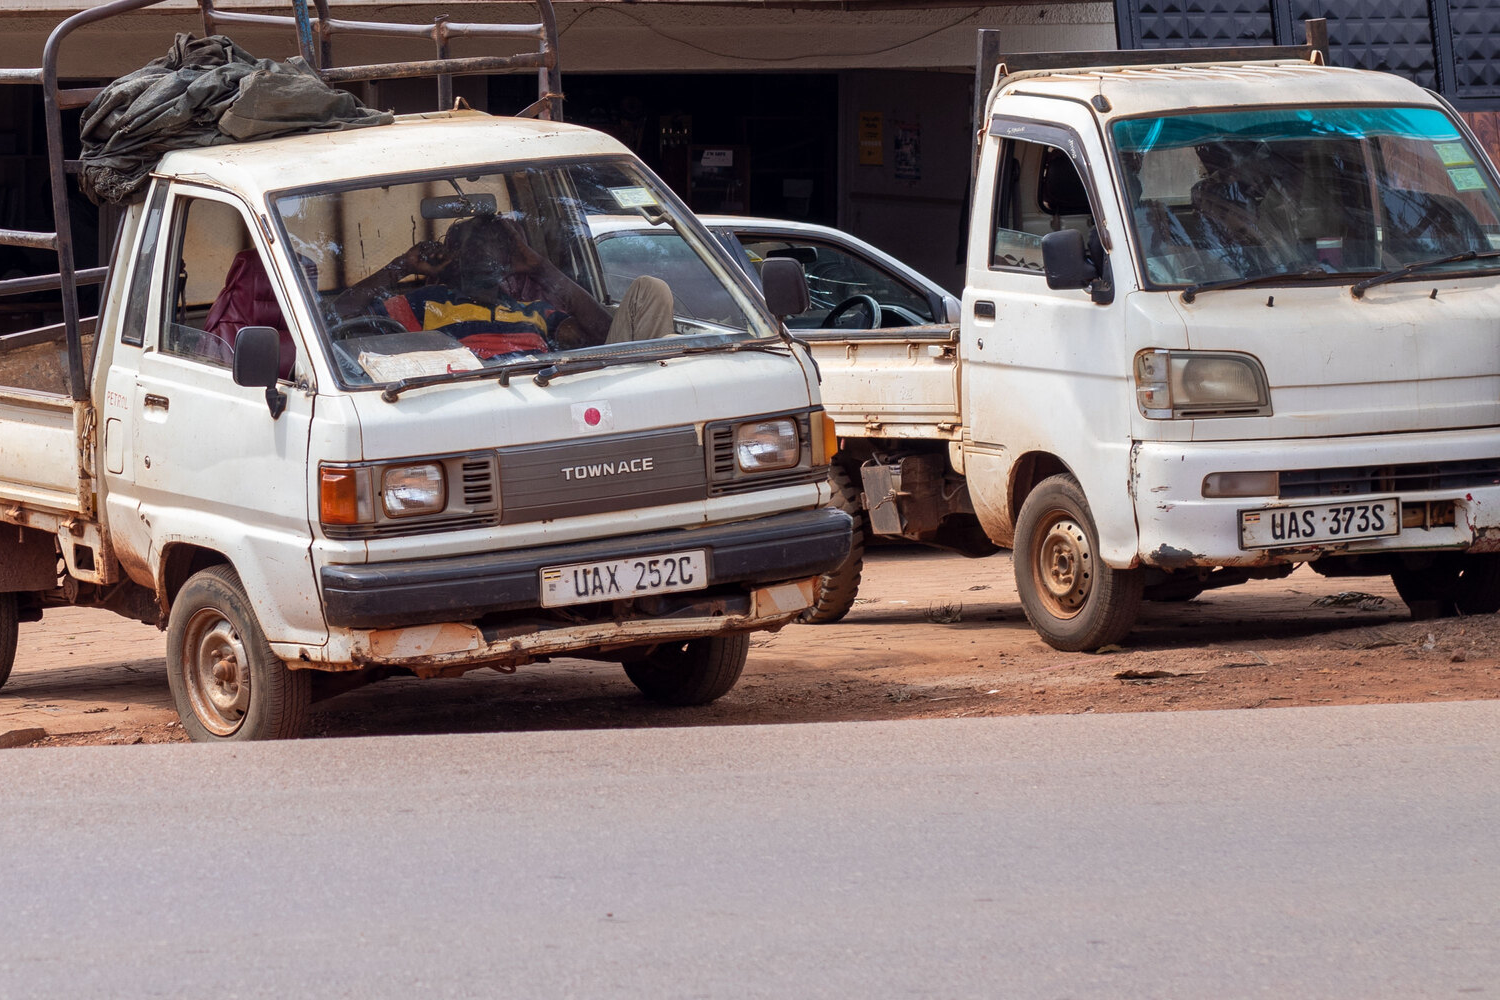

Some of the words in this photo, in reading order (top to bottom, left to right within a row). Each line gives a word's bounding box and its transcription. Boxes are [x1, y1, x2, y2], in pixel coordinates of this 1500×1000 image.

[107, 391, 128, 410] PETROL
[1272, 510, 1315, 540] UAS
[1329, 504, 1385, 535] 373S
[573, 563, 622, 598] UAX
[635, 556, 694, 590] 252C
